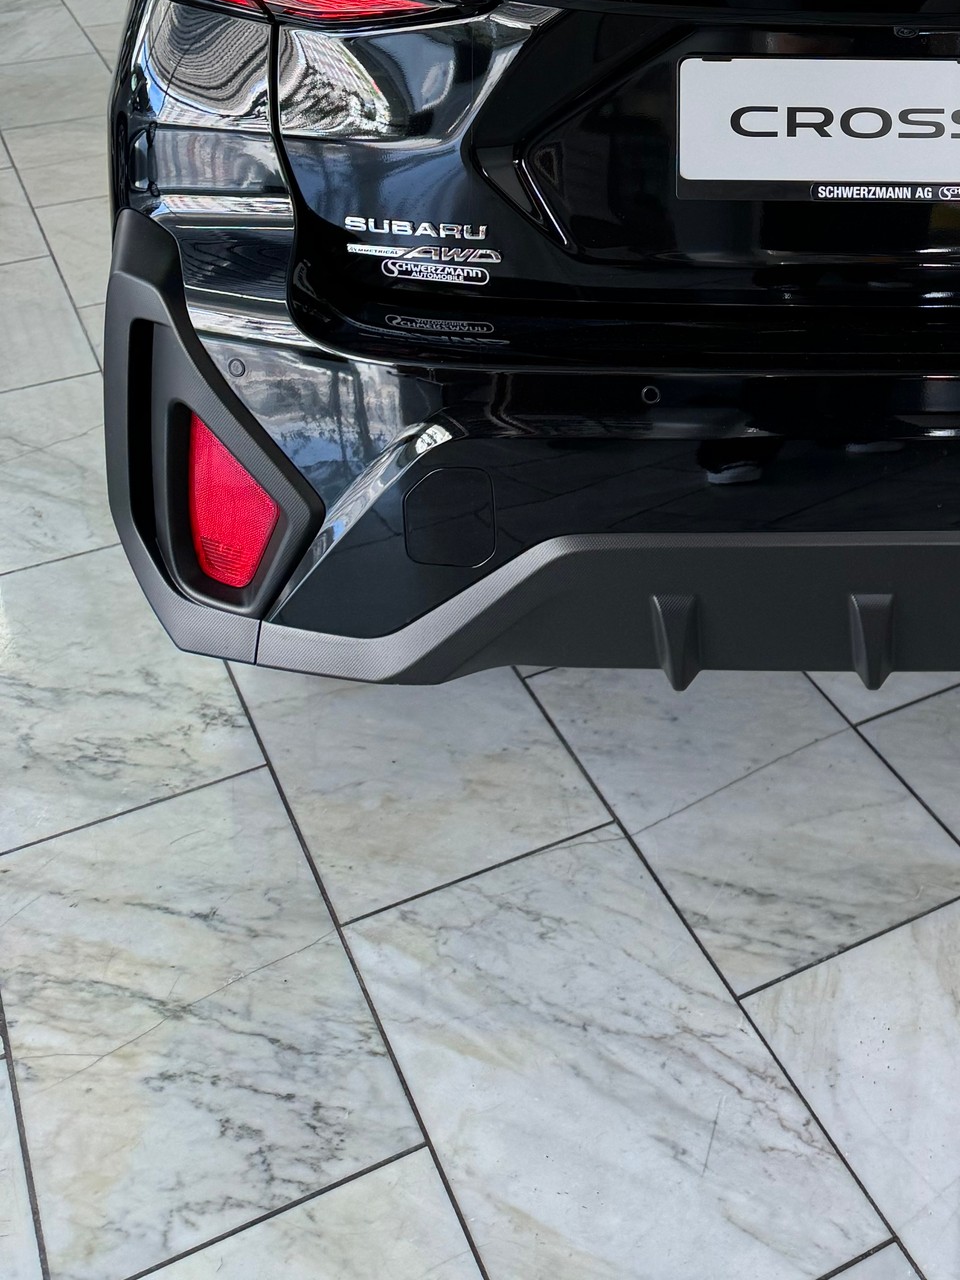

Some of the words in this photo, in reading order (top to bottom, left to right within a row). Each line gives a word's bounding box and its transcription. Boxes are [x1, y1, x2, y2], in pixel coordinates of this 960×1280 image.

[817, 185, 912, 199] SCHWERZMANN
[915, 186, 933, 199] AG
[344, 216, 488, 241] SUBARU
[349, 246, 399, 255] SYMMETRICAL
[402, 246, 502, 263] AWD
[387, 259, 482, 278] SCHWERZMANN
[411, 272, 464, 282] AUTOMOBILE
